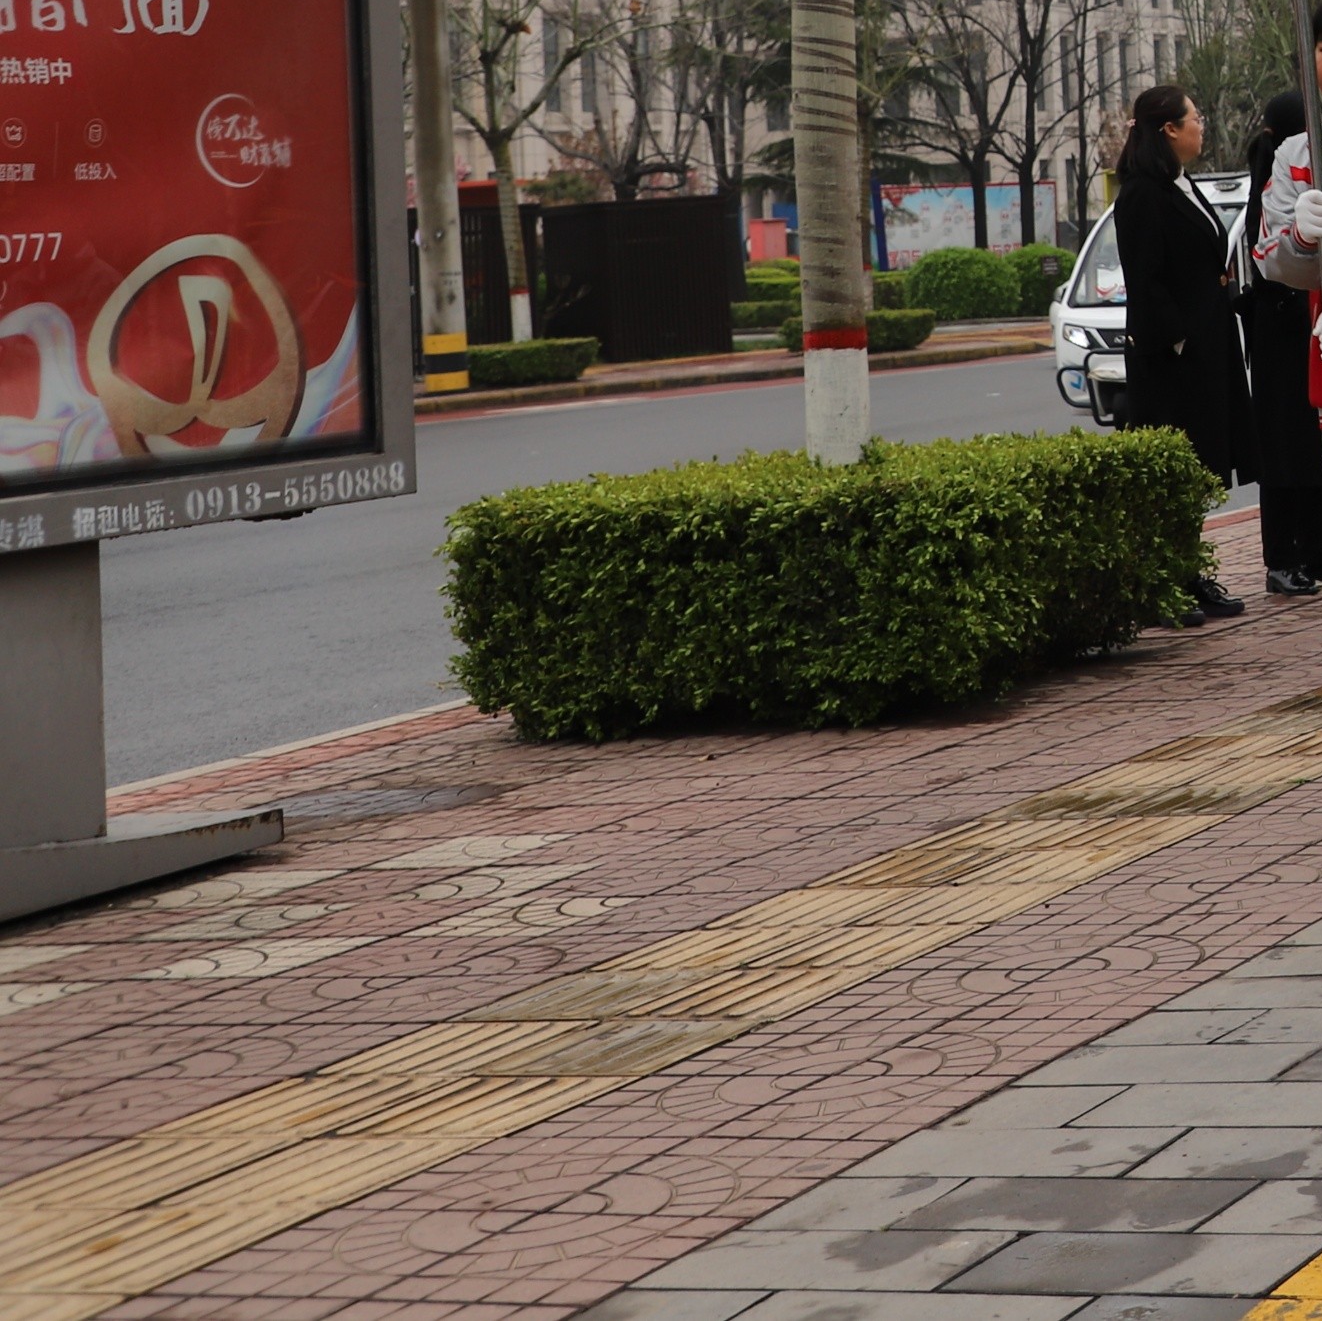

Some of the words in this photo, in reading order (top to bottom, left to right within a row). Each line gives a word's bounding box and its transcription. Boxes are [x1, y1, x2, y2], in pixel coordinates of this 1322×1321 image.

[0, 57, 72, 85] 热销中
[185, 461, 405, 521] 0913-5550888
